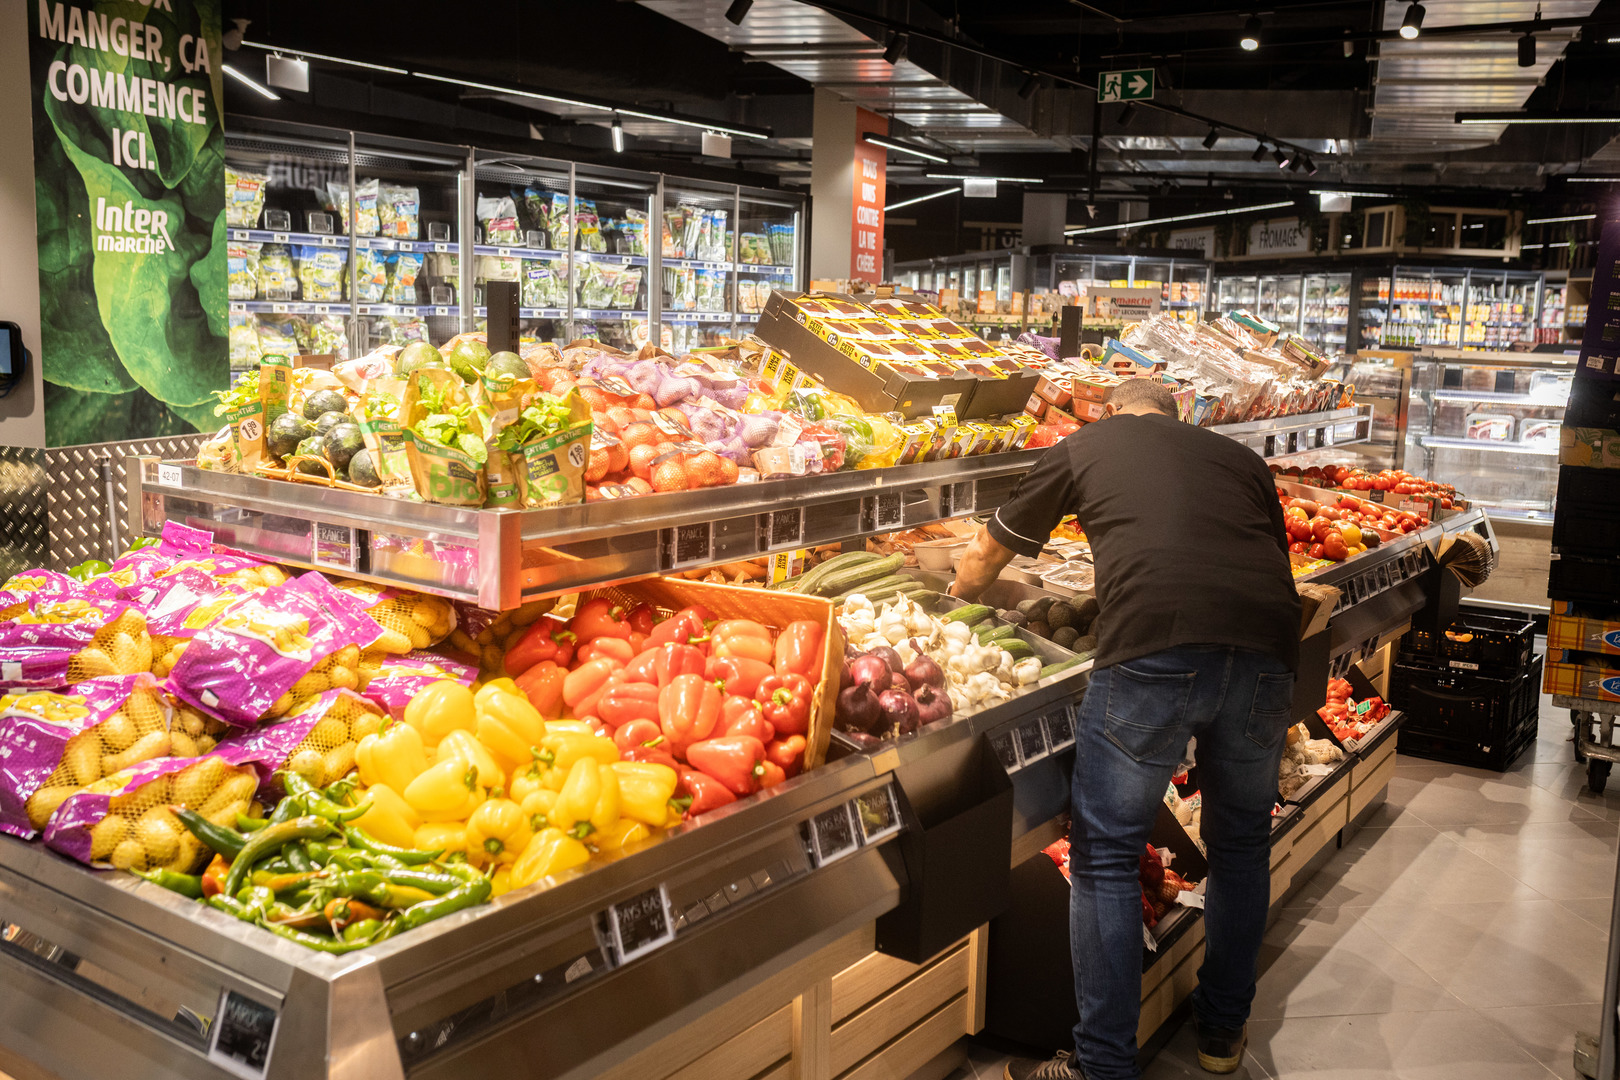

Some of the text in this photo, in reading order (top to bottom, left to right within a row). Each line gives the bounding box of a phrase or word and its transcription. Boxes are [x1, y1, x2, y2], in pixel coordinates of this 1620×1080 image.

[39, 1, 211, 74] MANGER, ÇA
[48, 60, 206, 125] COMMENCE
[113, 127, 155, 170] ICI.
[863, 158, 877, 179] TOUS
[862, 182, 876, 203] UNIS
[857, 205, 879, 228] CONTRE
[97, 233, 165, 255] marché
[859, 230, 866, 248] LA
[1259, 228, 1298, 249] FROMAGE
[555, 428, 581, 444] MENTHE
[162, 471, 179, 481] 42-07
[317, 527, 346, 543] FRANCE
[21, 630, 39, 644] 2kg
[617, 904, 641, 923] PAYS
